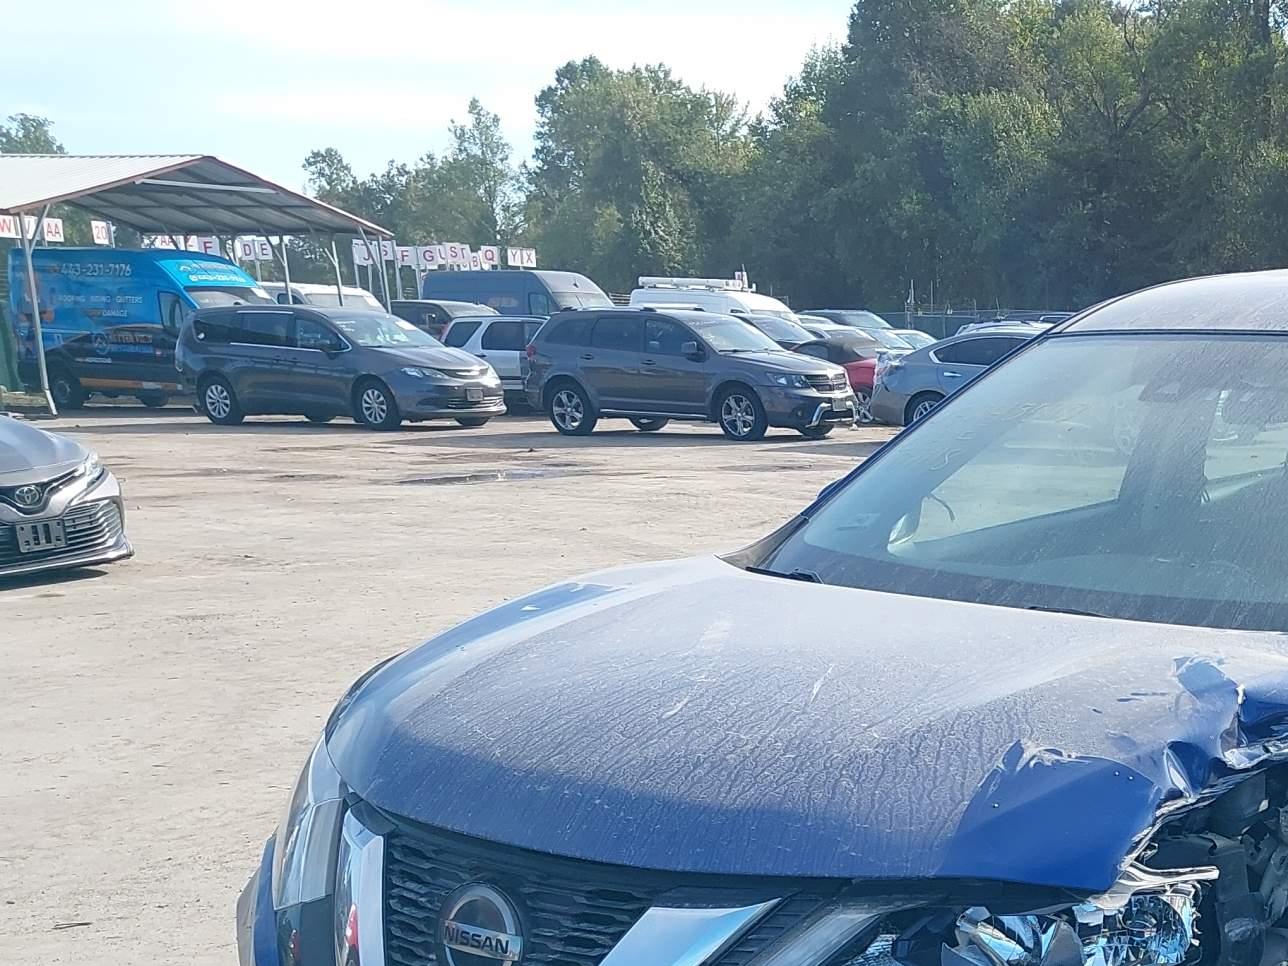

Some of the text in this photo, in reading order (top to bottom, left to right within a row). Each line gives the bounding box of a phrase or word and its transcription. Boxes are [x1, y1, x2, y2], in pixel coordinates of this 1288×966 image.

[46, 223, 61, 237] AA
[94, 226, 108, 240] 20
[243, 243, 253, 256] D
[261, 243, 269, 256] E
[401, 250, 409, 262] F
[423, 249, 435, 262] G
[450, 246, 458, 259] S
[484, 249, 495, 262] Q
[510, 250, 518, 263] Y
[526, 252, 534, 265] X
[61, 263, 132, 276] 443-231-7176
[443, 925, 510, 955] NISSAN
